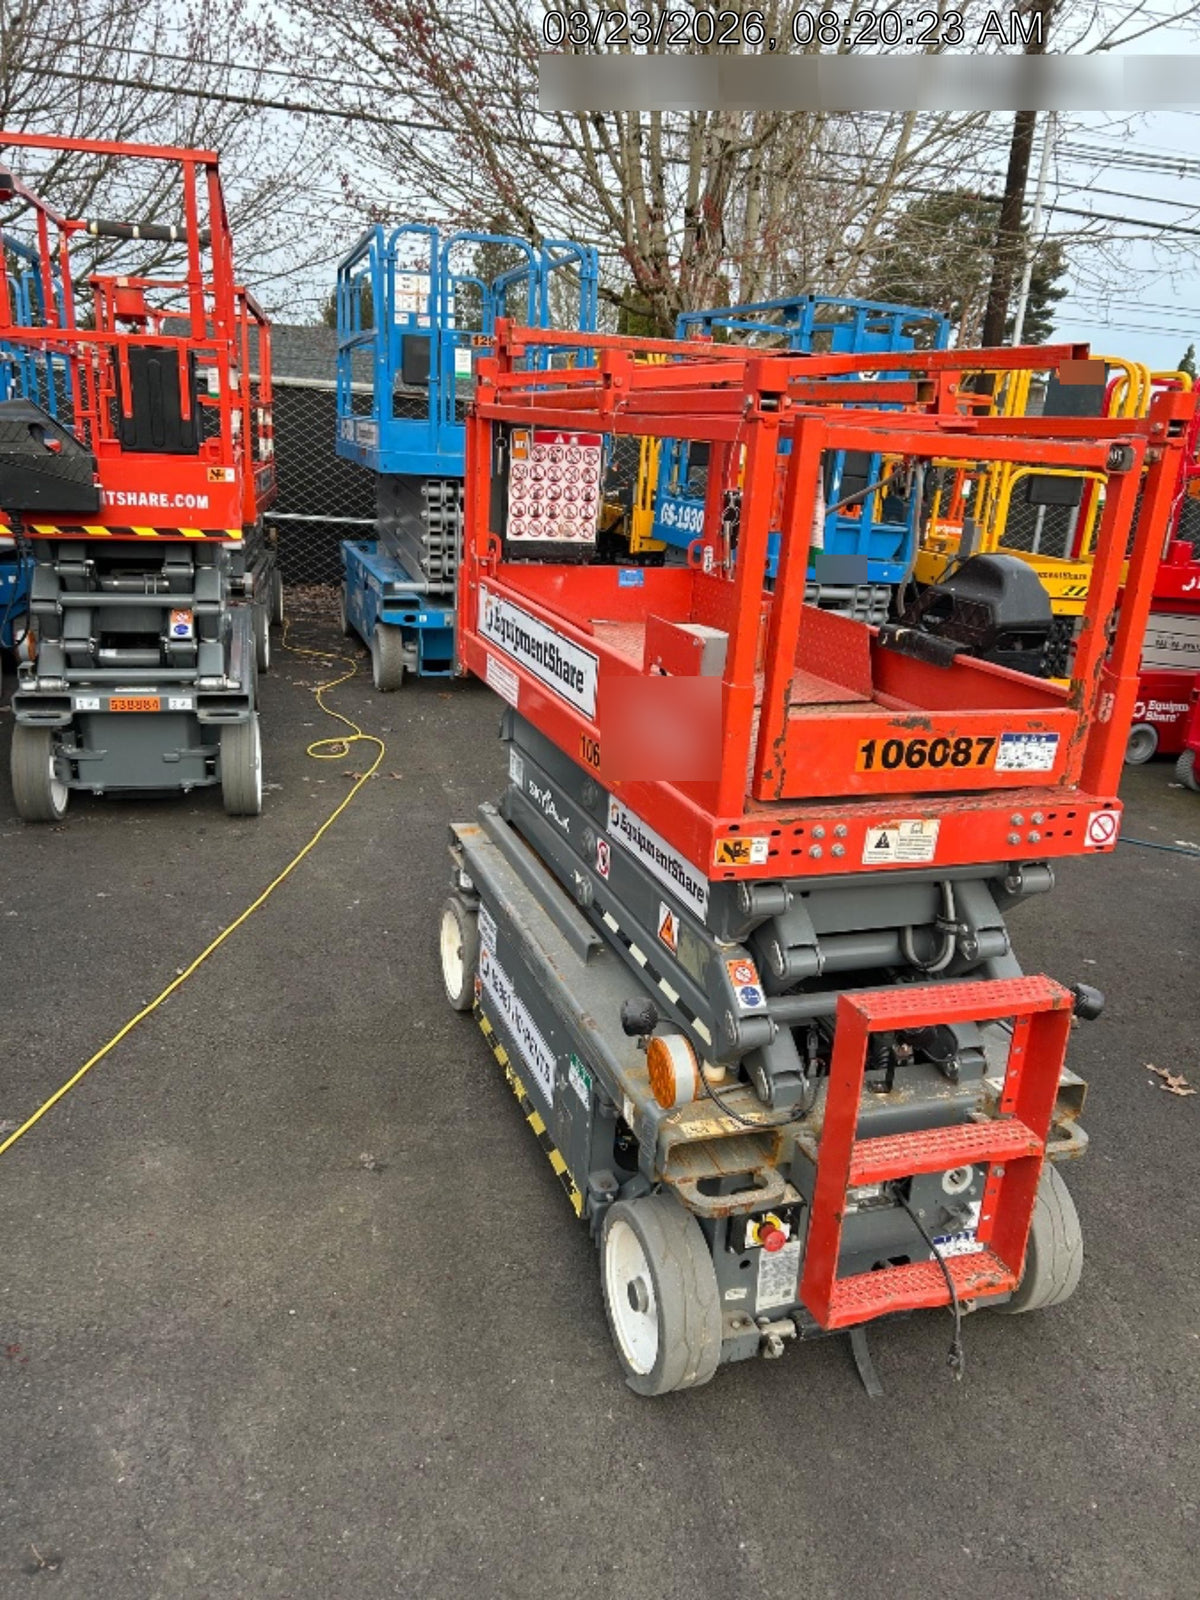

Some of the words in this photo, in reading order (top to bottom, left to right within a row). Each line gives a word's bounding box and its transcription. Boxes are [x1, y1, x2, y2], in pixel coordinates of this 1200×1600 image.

[660, 502, 705, 533] GS-1930
[494, 605, 584, 694] EquipmentShare
[861, 737, 996, 769] 106087
[620, 812, 705, 904] EquipmentShare
